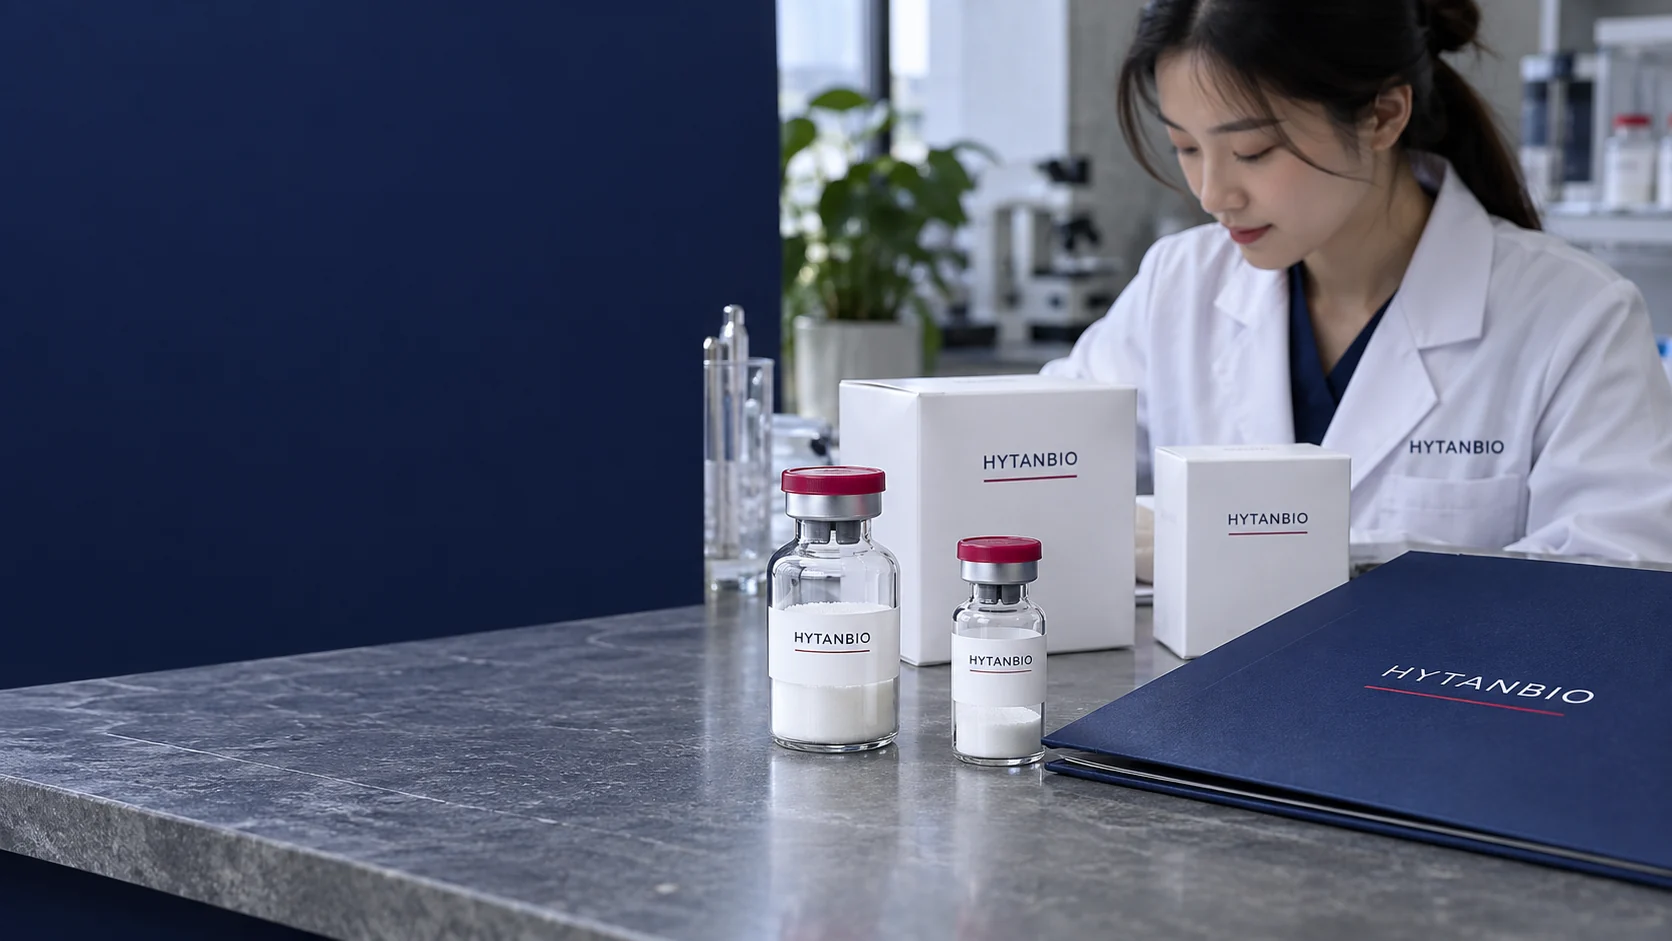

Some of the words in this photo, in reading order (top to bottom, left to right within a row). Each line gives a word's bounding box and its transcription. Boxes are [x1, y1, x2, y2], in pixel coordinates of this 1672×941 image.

[1408, 438, 1505, 455] HYTANBIO
[983, 450, 1078, 470] HYTANBIO
[1228, 512, 1309, 526] HYTANBIO
[794, 631, 871, 645] HYTANBIO
[969, 654, 1033, 667] HYTANBIO
[1381, 664, 1596, 705] HYTANBIO
